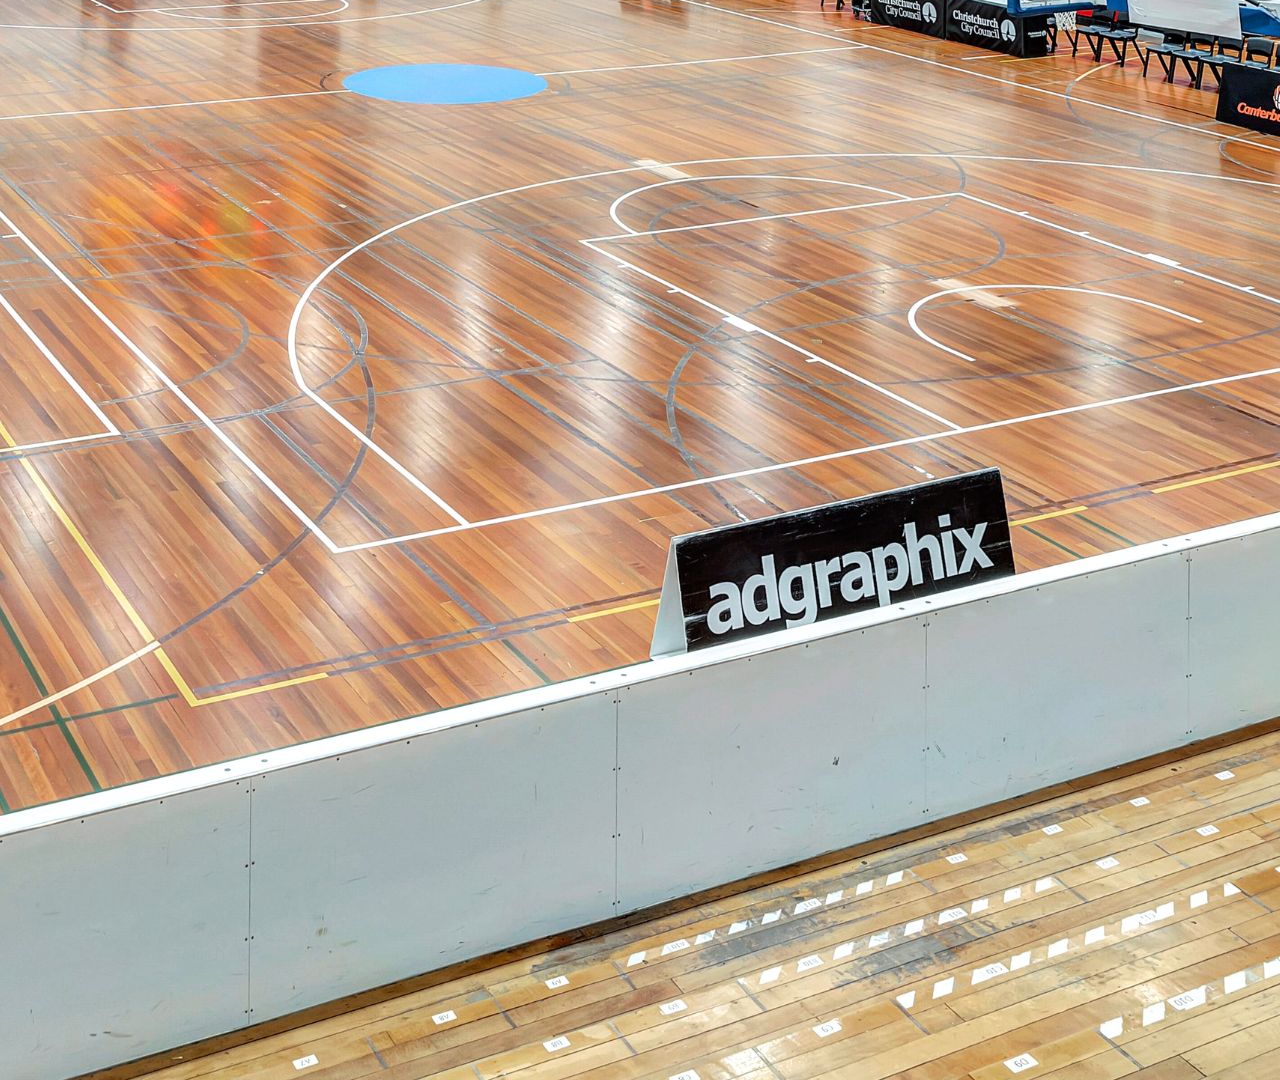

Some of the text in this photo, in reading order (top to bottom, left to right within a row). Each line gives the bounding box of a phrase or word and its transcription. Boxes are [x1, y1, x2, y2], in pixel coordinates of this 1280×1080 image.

[885, 5, 920, 21] City Council
[953, 10, 999, 29] Christchurch
[961, 22, 1000, 39] City Council
[706, 514, 994, 635] adgraphix
